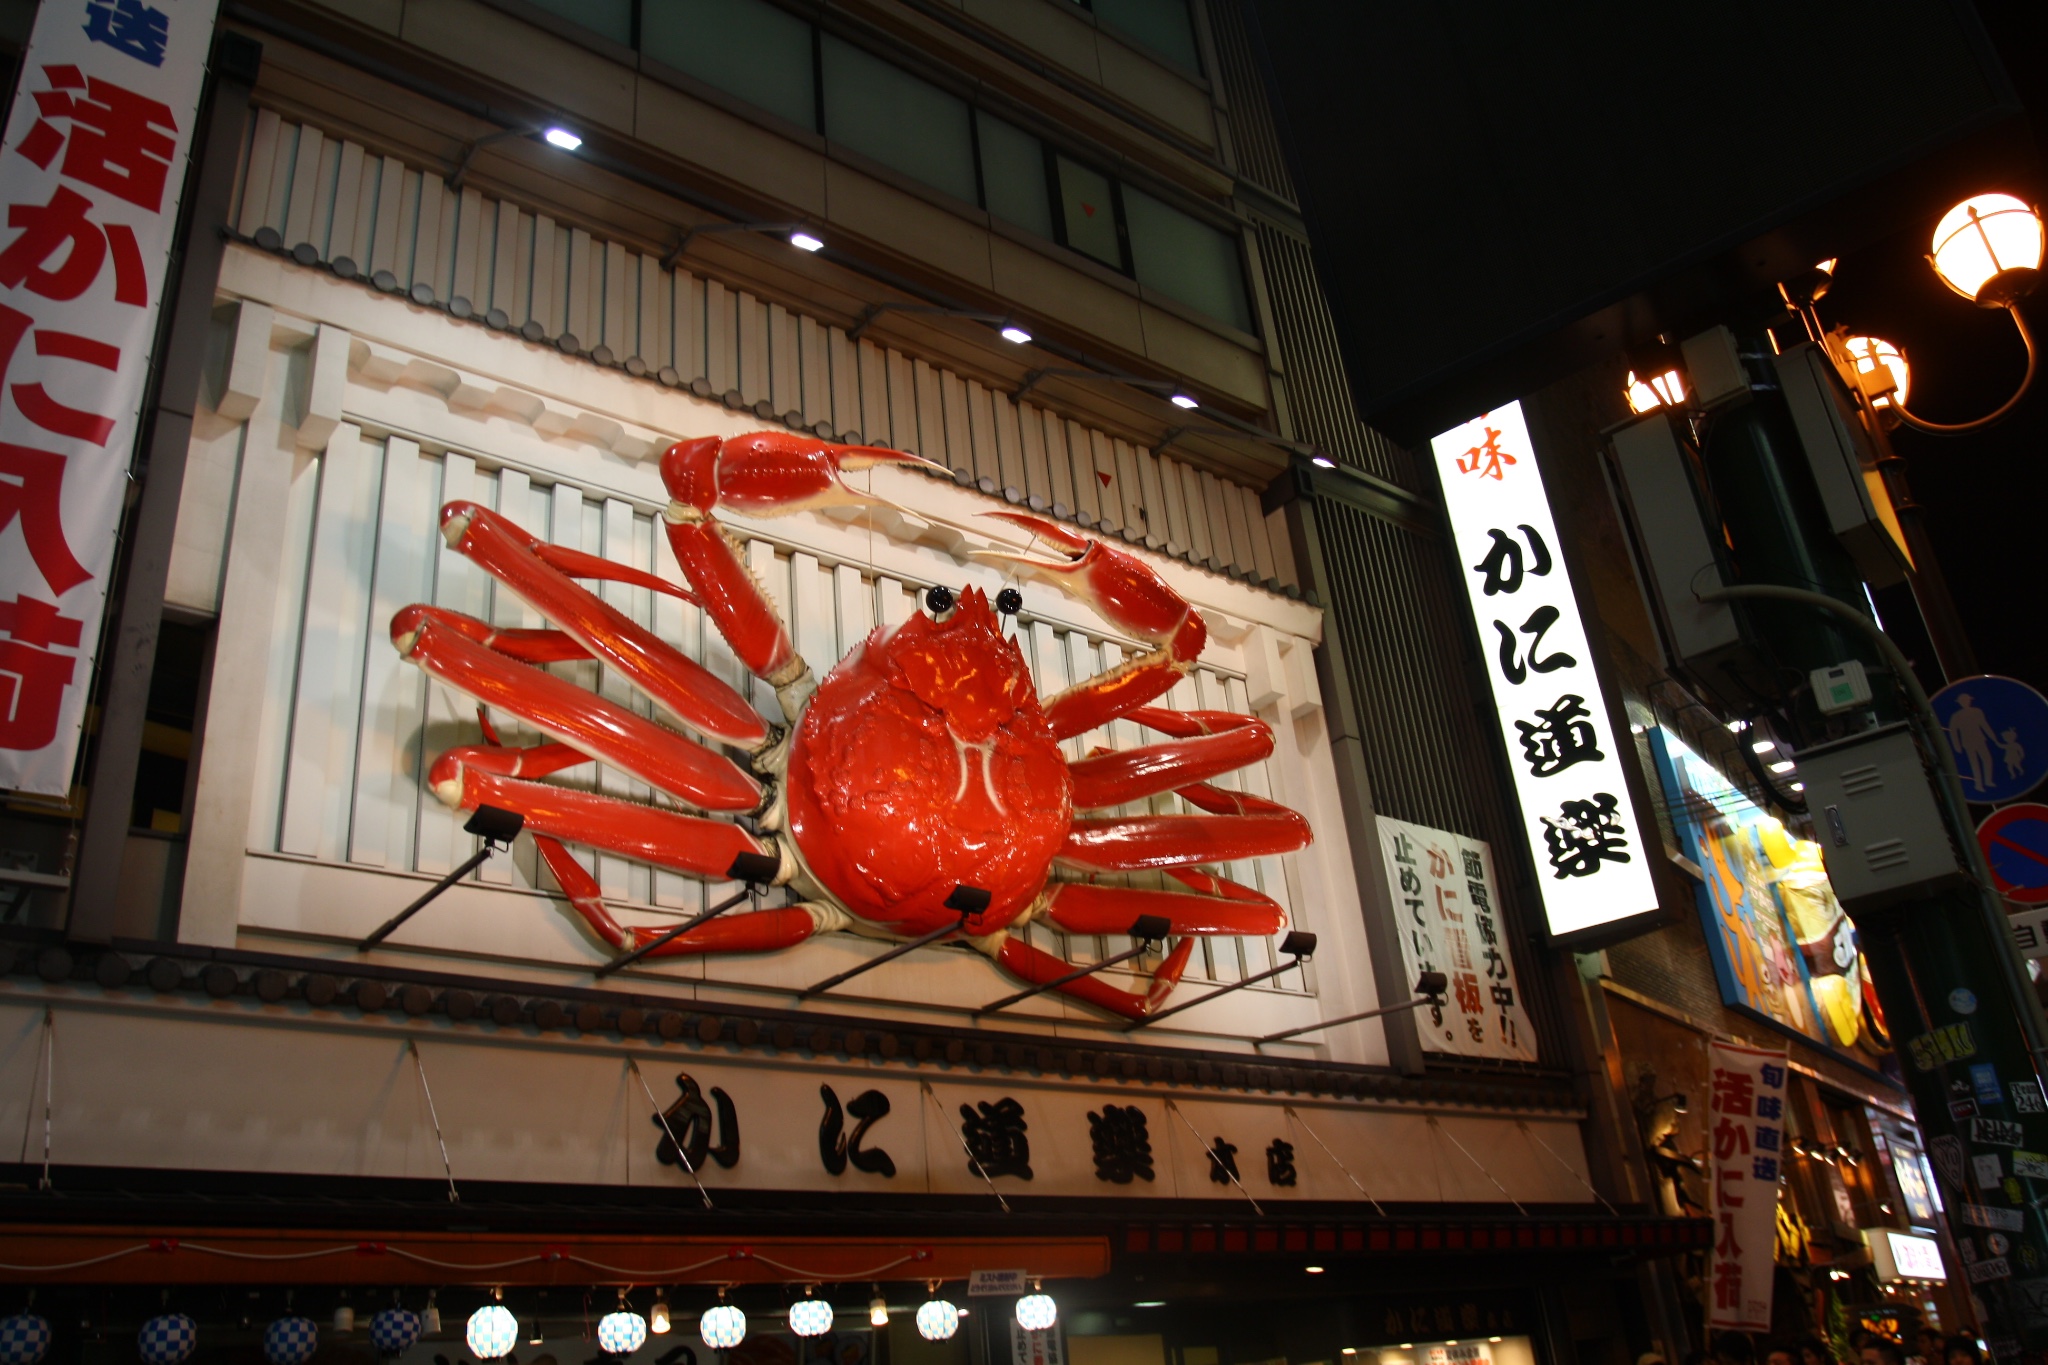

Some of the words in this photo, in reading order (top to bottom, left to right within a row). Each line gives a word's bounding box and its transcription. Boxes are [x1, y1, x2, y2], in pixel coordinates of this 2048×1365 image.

[1455, 413, 1517, 481] 味
[1393, 833, 1454, 1042] 止めていす。
[1711, 1068, 1754, 1310] 活かに入荷
[1752, 1063, 1785, 1182] 旬味直送
